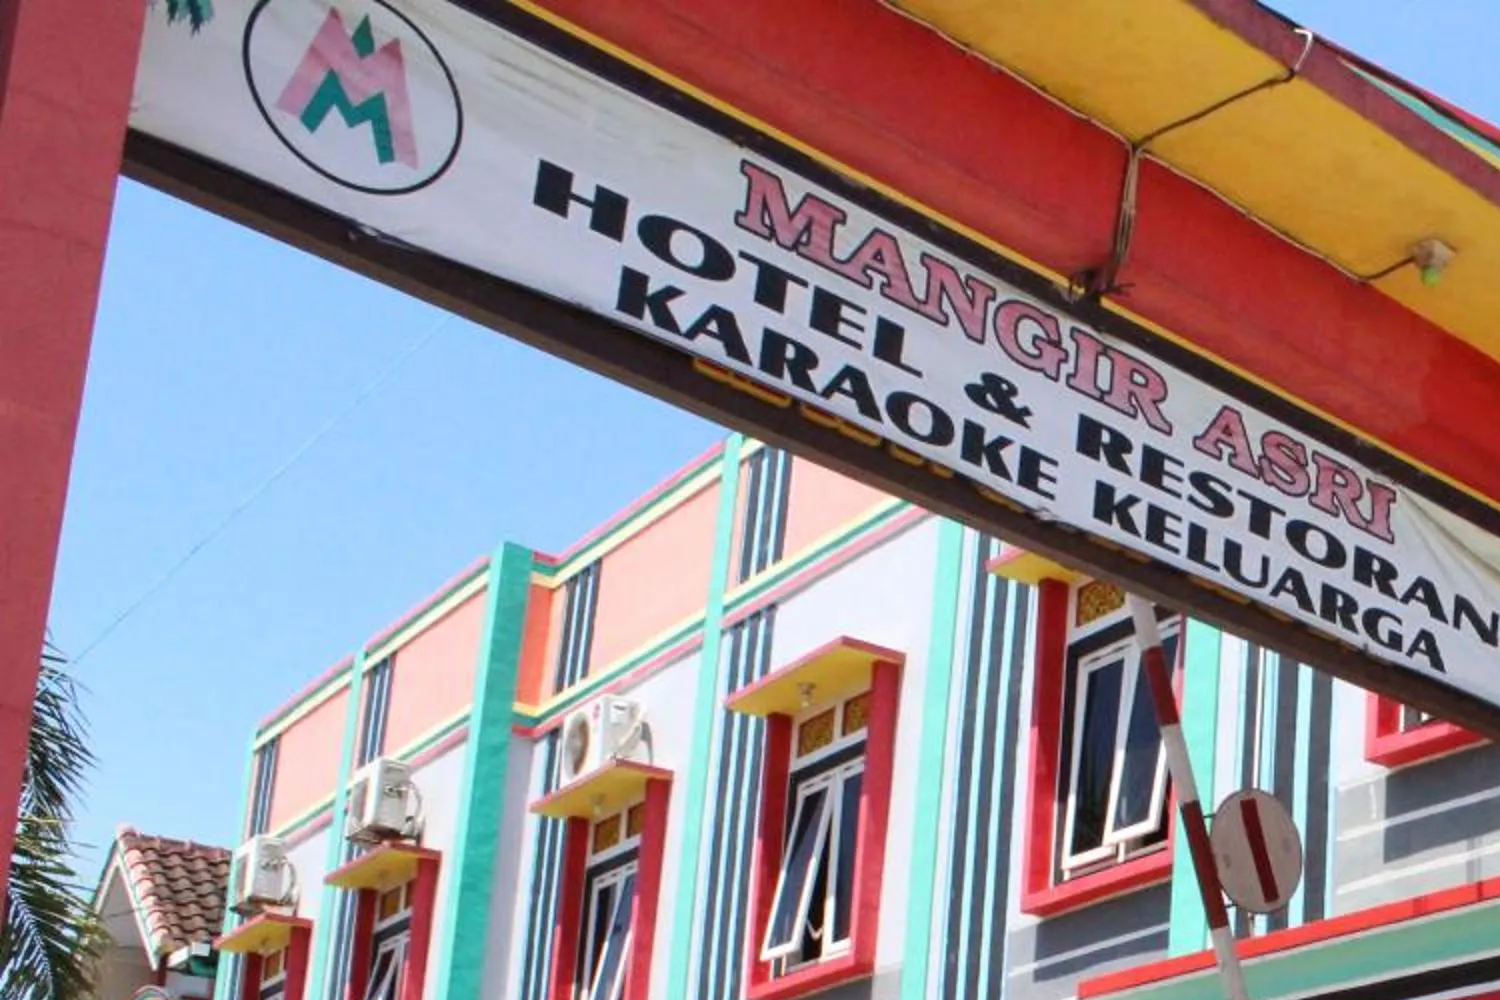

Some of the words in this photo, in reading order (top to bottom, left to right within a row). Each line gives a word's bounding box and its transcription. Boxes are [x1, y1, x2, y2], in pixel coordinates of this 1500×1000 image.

[532, 158, 924, 379] HOTEL
[964, 371, 1033, 430] &
[1075, 412, 1500, 648] RESTORAN
[615, 264, 1059, 502] KARAOKE
[1092, 478, 1448, 674] KELUARGA
[735, 158, 1174, 437] MANGIR
[1193, 404, 1398, 546] ASRI
